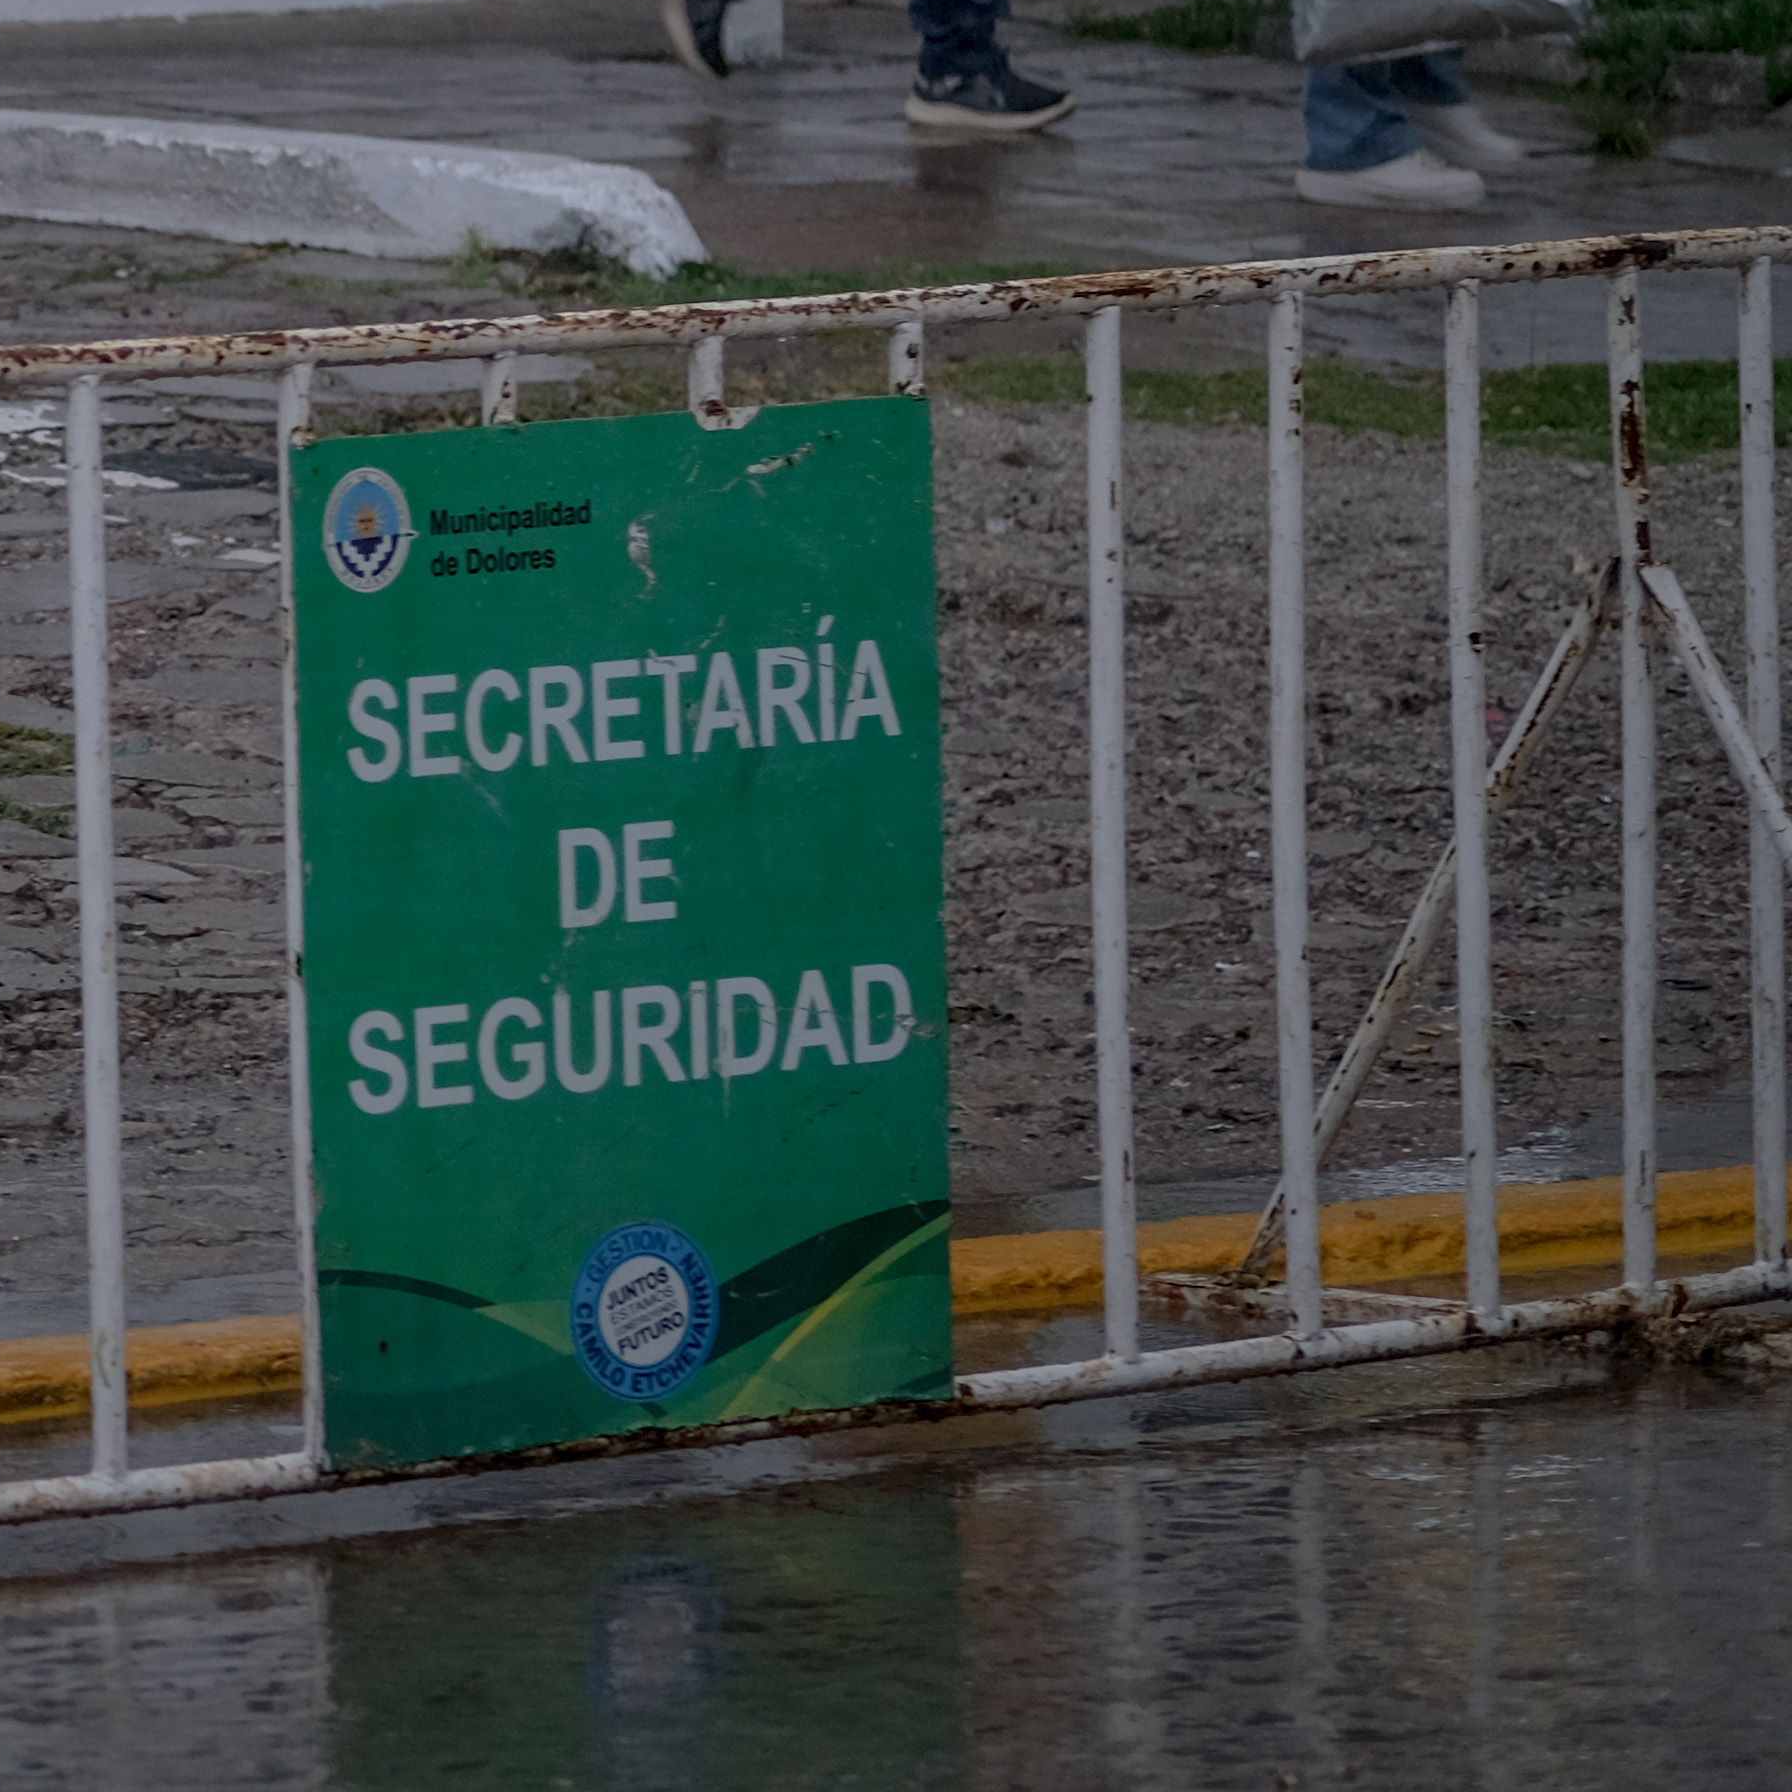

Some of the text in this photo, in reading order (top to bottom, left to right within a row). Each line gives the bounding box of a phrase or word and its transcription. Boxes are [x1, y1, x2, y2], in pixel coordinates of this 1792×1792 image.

[429, 499, 593, 536] Municipalidad
[430, 551, 460, 578] de
[466, 546, 557, 576] Dolores
[346, 614, 902, 784] SECRETARÍA
[557, 819, 679, 930] DE
[347, 963, 916, 1116] SEGURIDAD
[606, 1265, 669, 1310] JUNTOS
[616, 1311, 685, 1356] FUTURO
